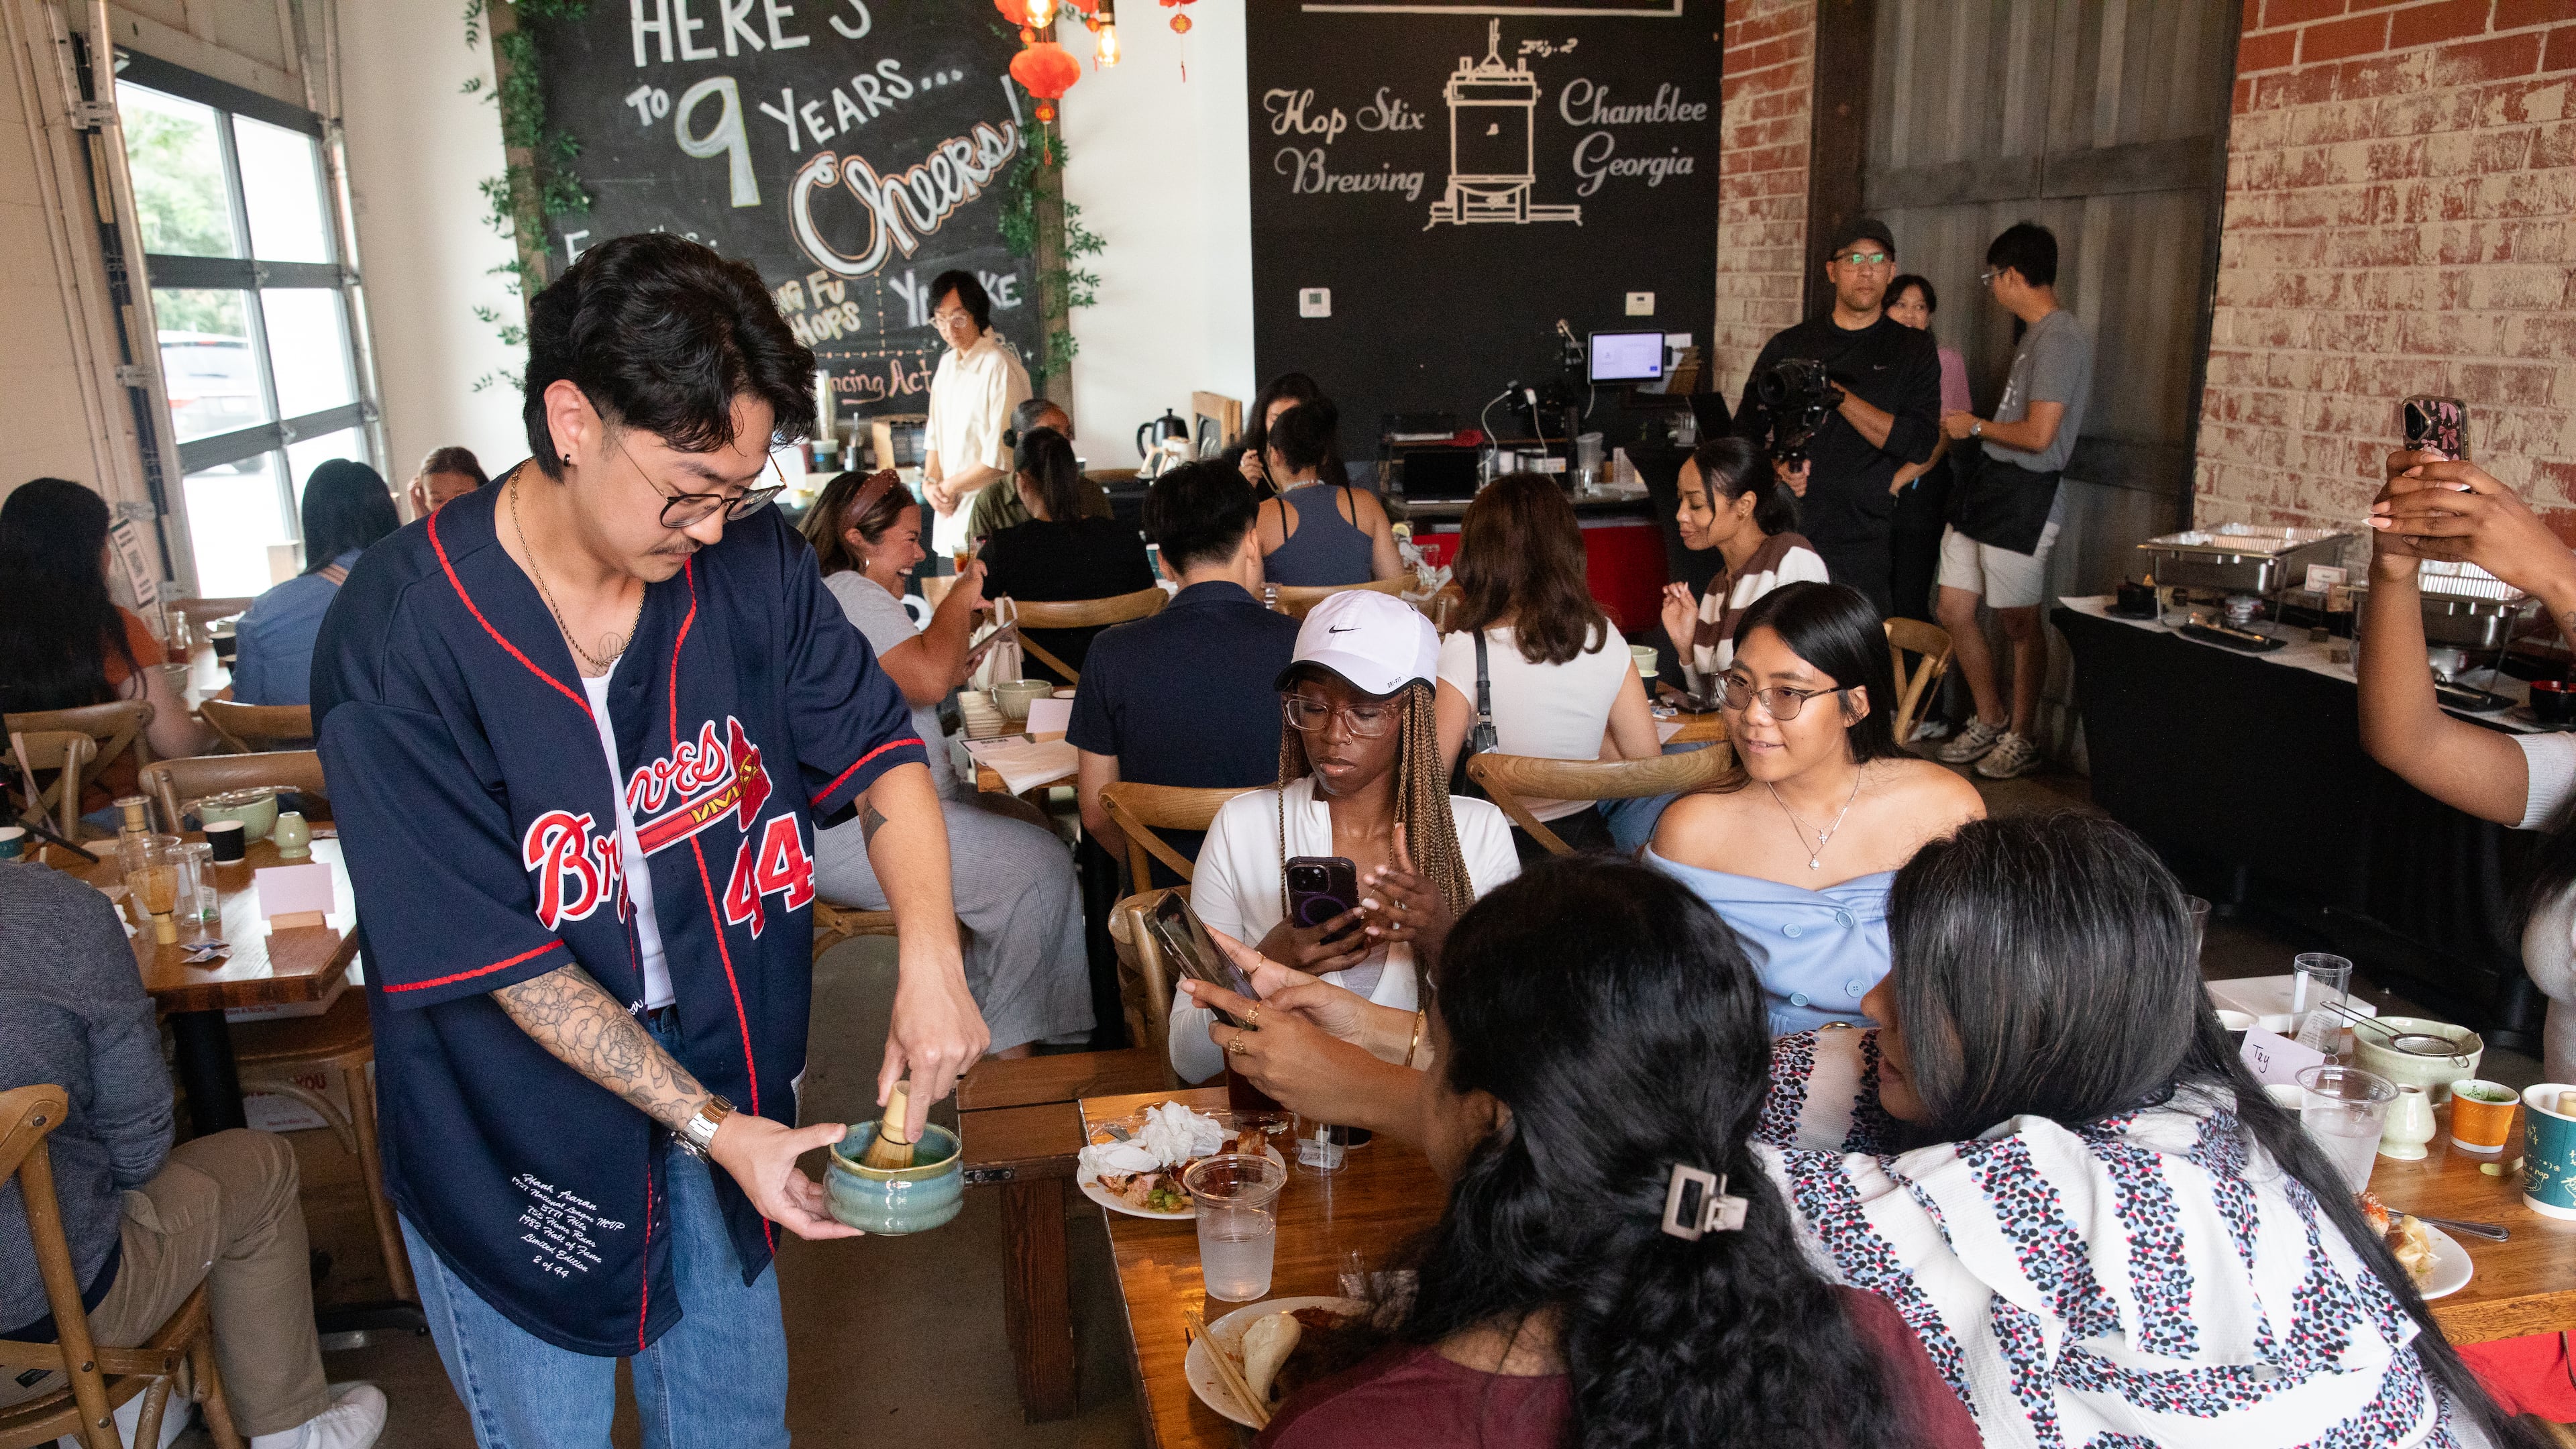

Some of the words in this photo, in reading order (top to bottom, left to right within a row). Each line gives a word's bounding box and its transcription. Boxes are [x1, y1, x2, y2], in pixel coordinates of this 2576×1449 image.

[1263, 88, 1347, 145] Hop
[1355, 86, 1426, 132] Stix
[1558, 77, 1708, 127] Chamblee
[625, 85, 669, 126] TO
[674, 75, 761, 208] 9
[1274, 146, 1425, 202] Brewing
[1572, 131, 1695, 197] Georgia
[792, 300, 861, 348] HOPS
[1387, 676, 1402, 688] DRI-FIT
[722, 811, 816, 940] 44
[2253, 1044, 2270, 1073] Tay
[523, 1173, 554, 1193] Hank
[2534, 1169, 2550, 1184] nap
[528, 1205, 544, 1220] 755
[545, 1216, 570, 1234] Home
[572, 1230, 596, 1248] Runs
[530, 1188, 566, 1209] National
[564, 1206, 594, 1223] League
[596, 1217, 625, 1231] MVP
[566, 1215, 587, 1231] Hits
[519, 1214, 541, 1230] 1982
[543, 1226, 566, 1243] Hall
[565, 1241, 576, 1250] of
[576, 1245, 602, 1263] Fame
[521, 1233, 557, 1254] Limited
[555, 1250, 588, 1273] Edition
[533, 1255, 543, 1264] 2
[542, 1262, 554, 1271] of
[554, 1267, 570, 1279] 44
